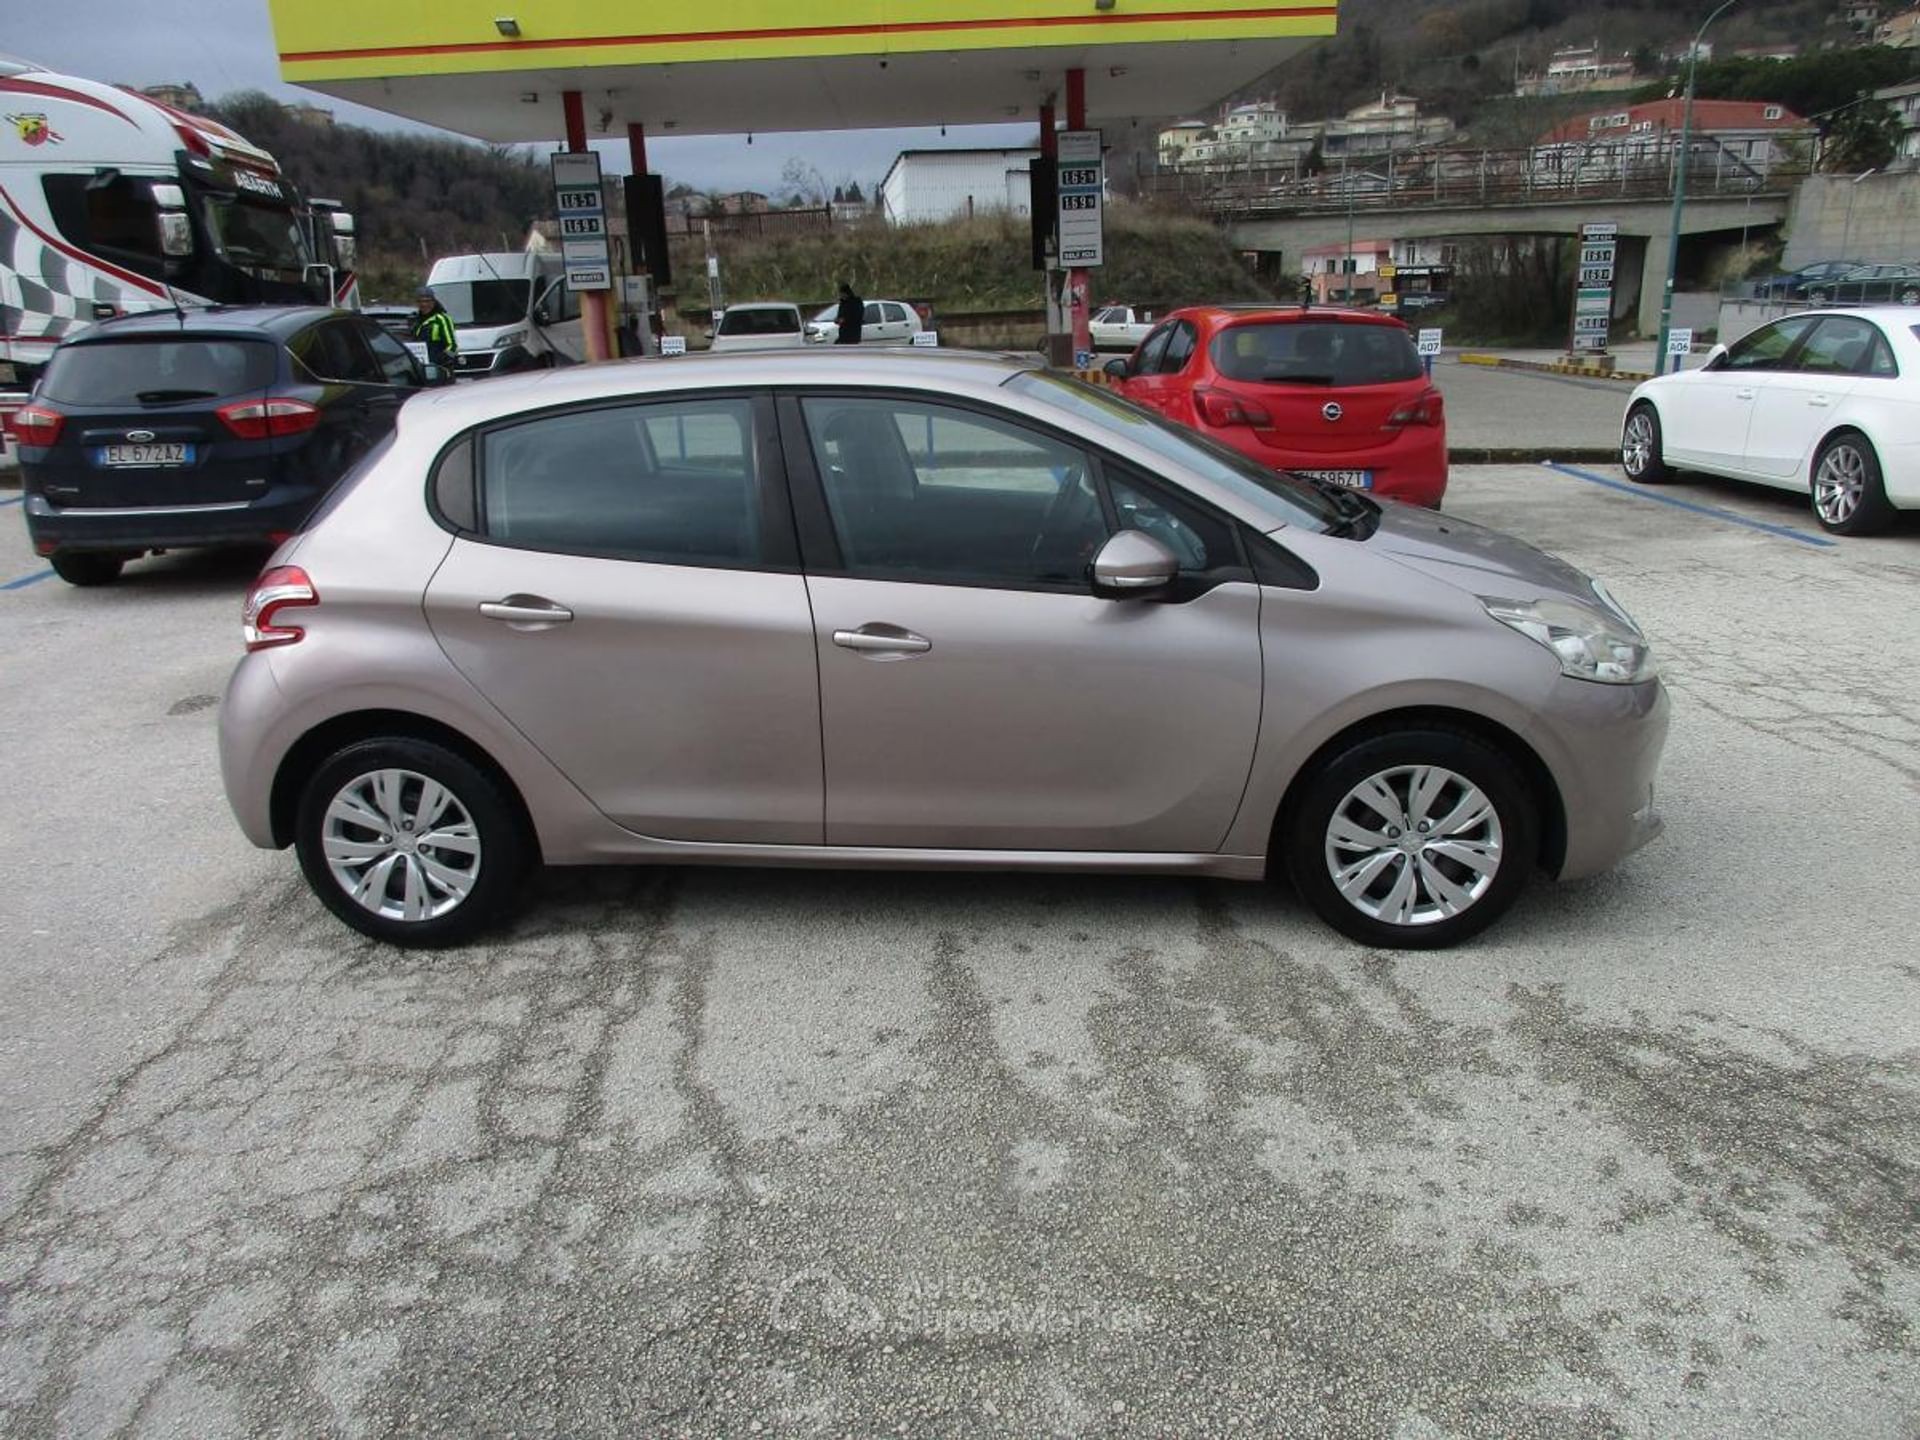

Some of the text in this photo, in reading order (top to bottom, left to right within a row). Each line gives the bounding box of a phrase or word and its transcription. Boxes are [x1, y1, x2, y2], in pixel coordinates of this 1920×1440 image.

[1419, 343, 1440, 352] A07
[1669, 342, 1689, 352] A06
[108, 445, 184, 462] EL 672AZ
